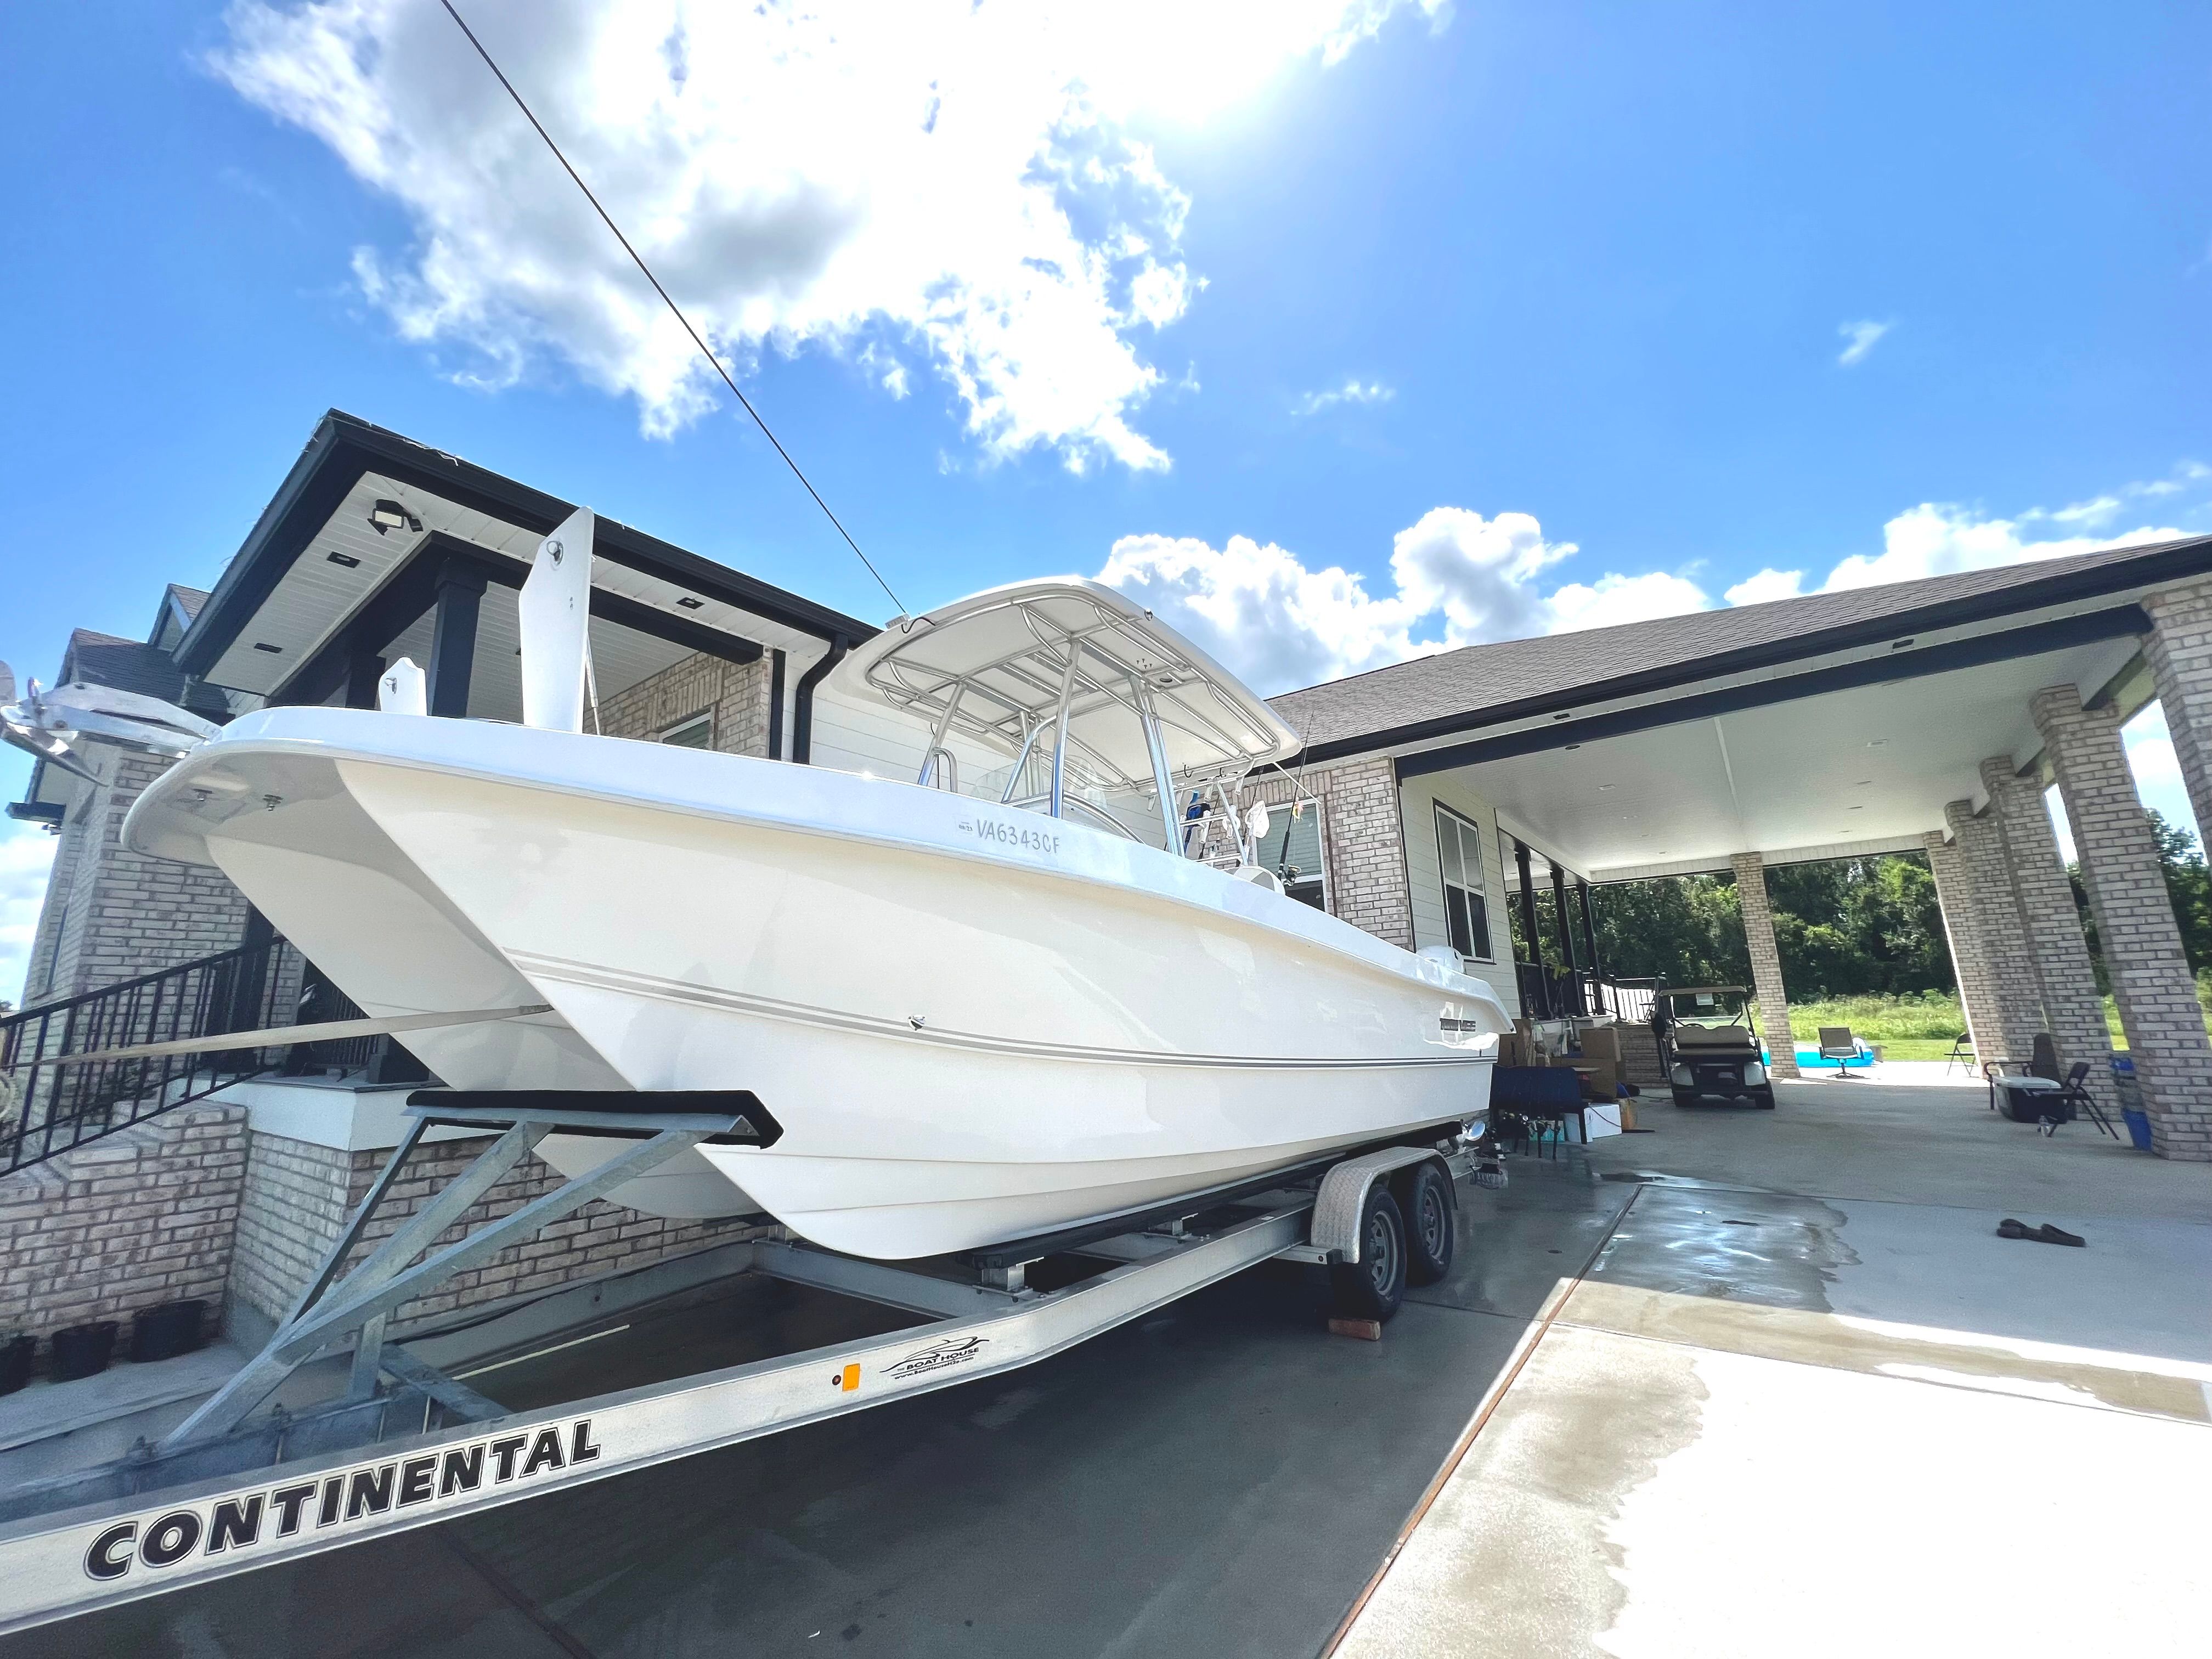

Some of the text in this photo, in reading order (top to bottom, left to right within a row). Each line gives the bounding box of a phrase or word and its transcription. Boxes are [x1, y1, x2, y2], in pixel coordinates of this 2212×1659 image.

[906, 1357, 938, 1370] BOAT
[941, 1347, 979, 1361] HOUSE
[82, 1418, 602, 1581] CONTINENTAL
